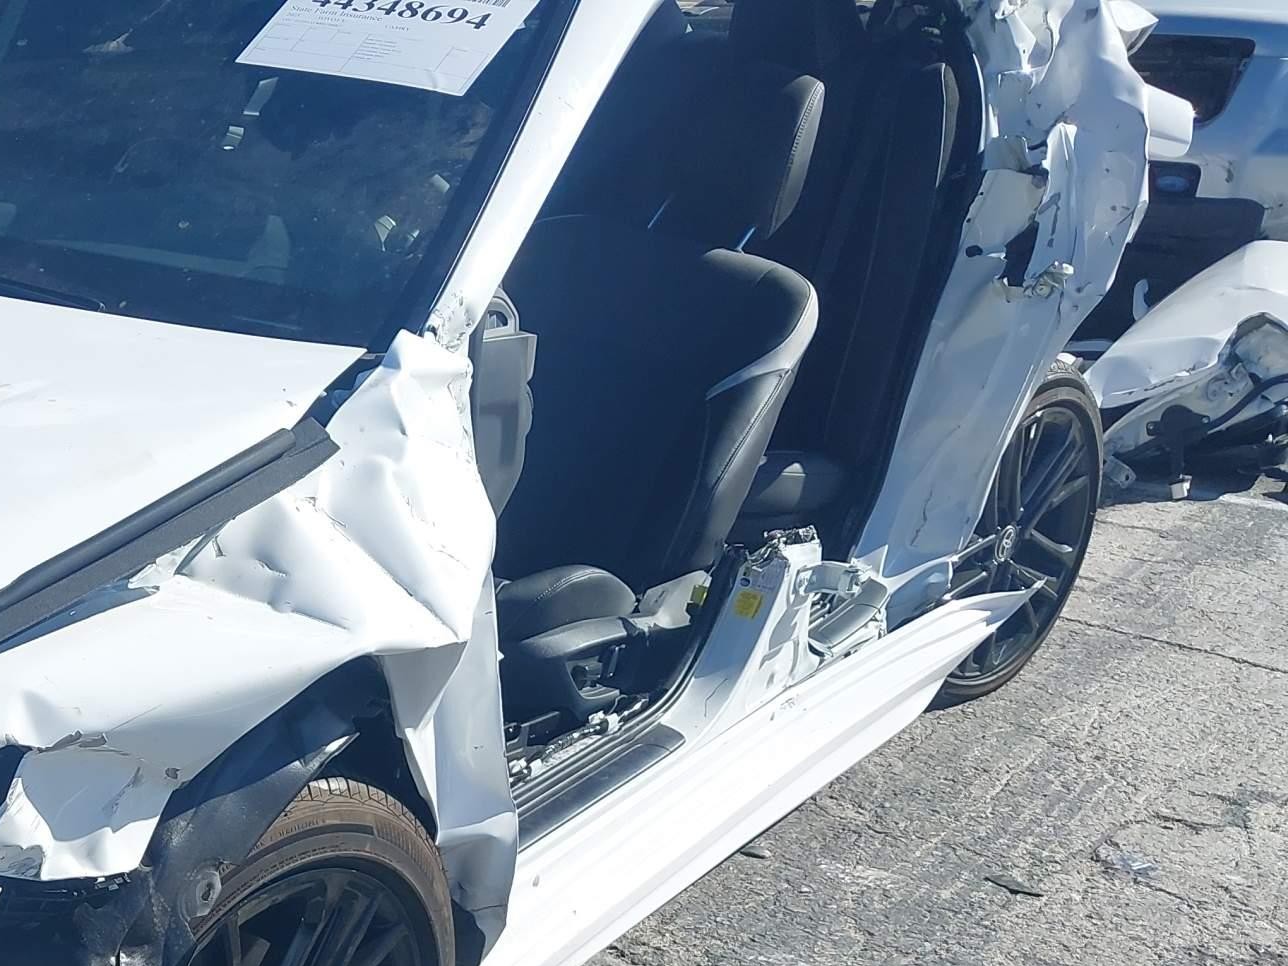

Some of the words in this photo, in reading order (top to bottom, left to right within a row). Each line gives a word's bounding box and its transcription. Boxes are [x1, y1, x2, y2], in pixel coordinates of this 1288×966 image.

[291, 5, 312, 14] State
[314, 7, 338, 16] Farm
[339, 10, 383, 22] Insurance
